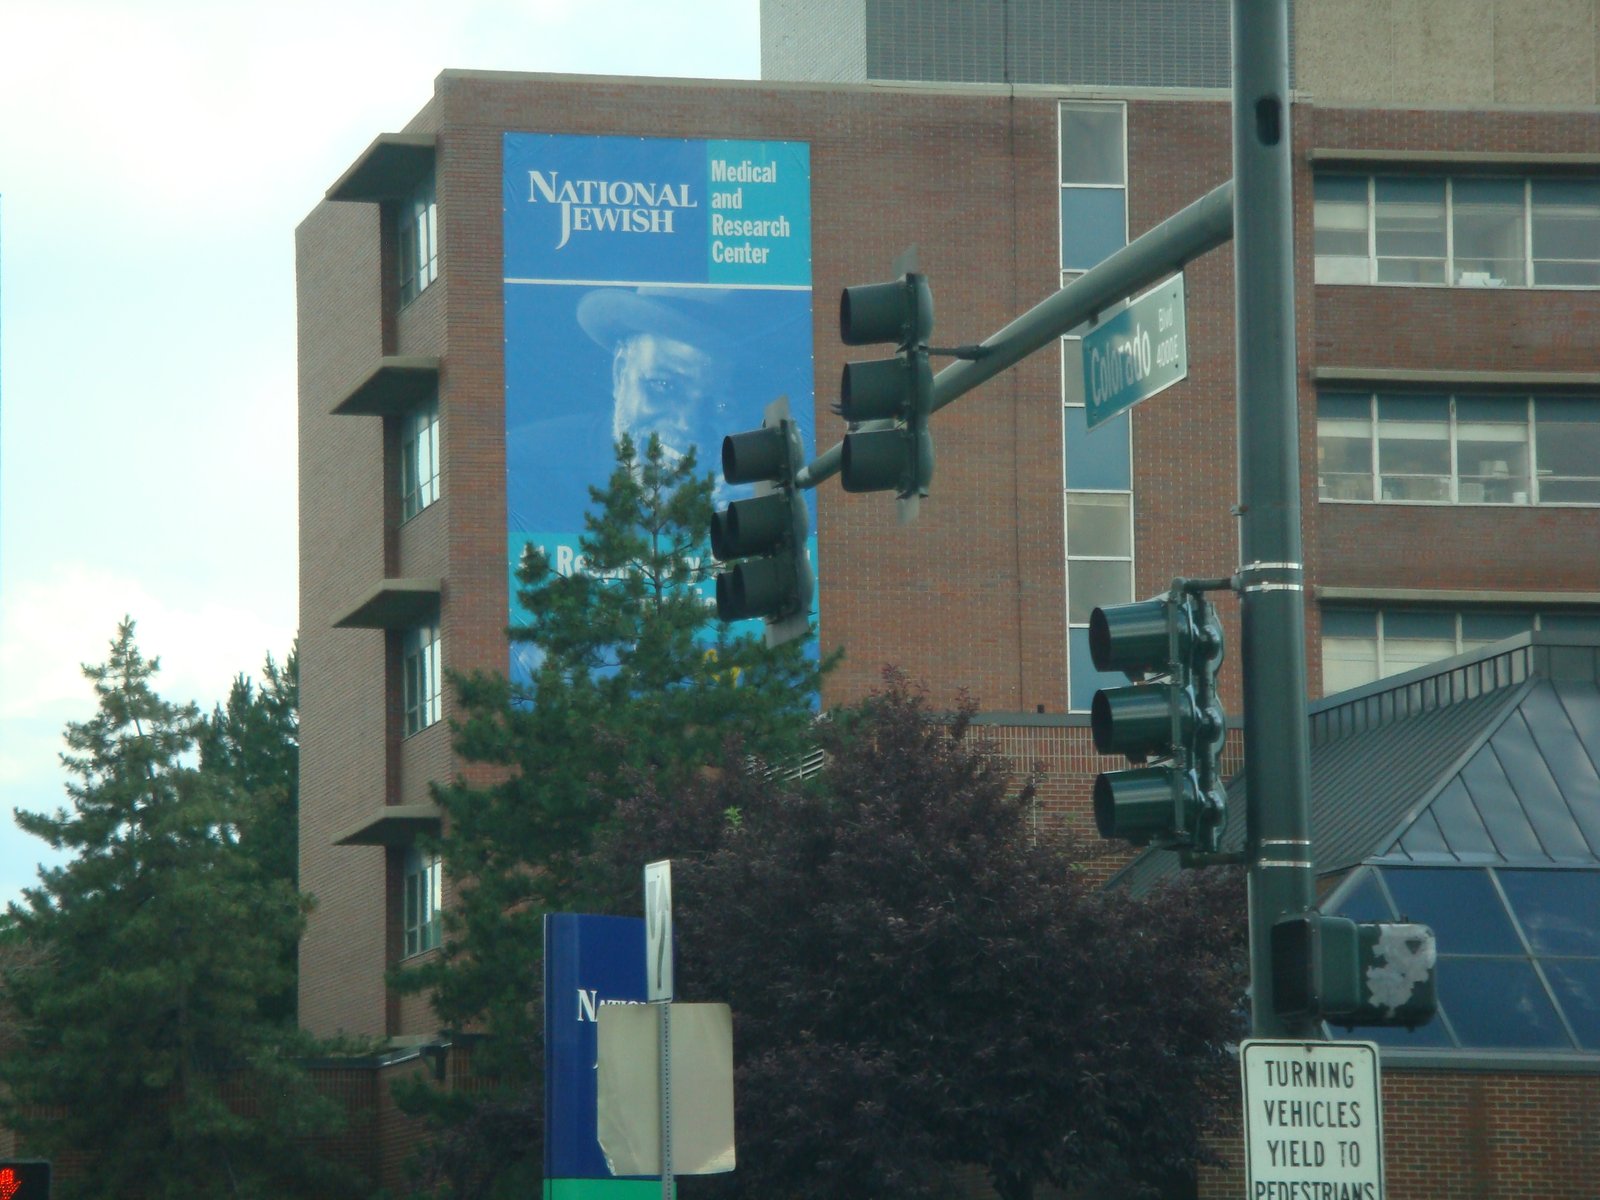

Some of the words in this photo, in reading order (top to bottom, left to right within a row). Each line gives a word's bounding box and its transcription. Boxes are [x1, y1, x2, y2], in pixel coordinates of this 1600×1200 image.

[711, 159, 777, 184] Medical
[527, 170, 698, 209] NATIONAL
[711, 188, 743, 210] and
[555, 201, 675, 250] JEWISH
[711, 213, 791, 238] Research
[711, 241, 770, 264] Center
[1091, 322, 1151, 407] Colorado
[1264, 1060, 1354, 1089] TURNING
[1263, 1100, 1362, 1128] VEHICLES
[1267, 1140, 1326, 1168] YIELD
[1337, 1141, 1361, 1168] TO
[1254, 1180, 1375, 1200] PEDESTRIANS
